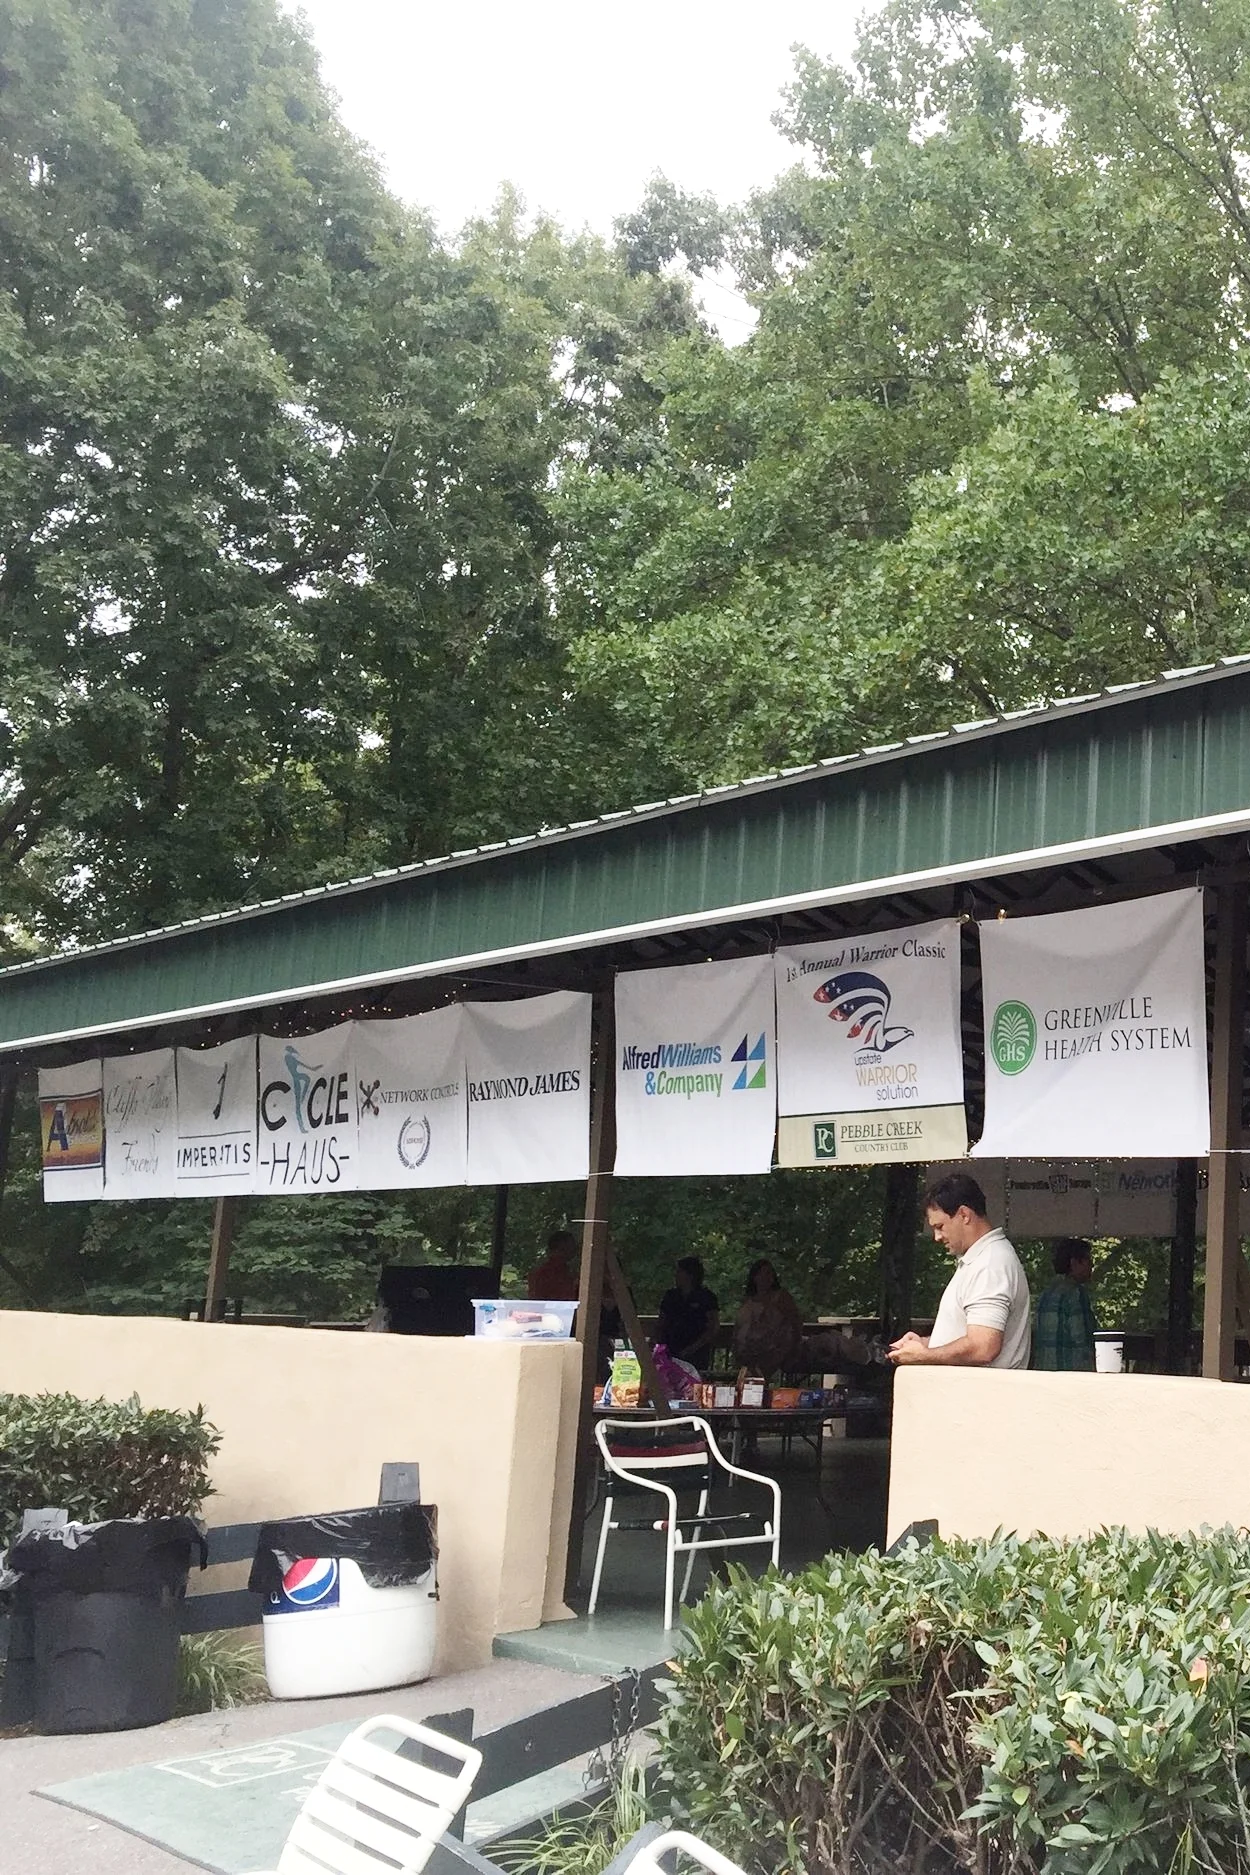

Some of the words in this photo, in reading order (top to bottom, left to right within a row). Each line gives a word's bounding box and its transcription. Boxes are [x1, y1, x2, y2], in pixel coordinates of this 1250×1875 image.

[800, 951, 845, 976] Annual
[850, 944, 898, 964] Warrior
[902, 939, 946, 959] Classic
[1044, 996, 1153, 1031] GREENVILLE
[999, 1043, 1026, 1062] GHS
[1045, 1031, 1102, 1060] HEALTH
[1111, 1026, 1192, 1051] SYSTEM
[855, 1053, 882, 1066] upstate
[856, 1063, 918, 1086] WARRIOR
[469, 1077, 526, 1102] RAYMOND
[529, 1070, 581, 1096] JAMES
[877, 1085, 919, 1101] solution
[380, 1088, 428, 1104] NETWORK
[841, 1123, 884, 1139] PEBBLE
[886, 1121, 923, 1137] CREEK
[854, 1143, 889, 1154] COUNTRY
[890, 1141, 909, 1152] CLUB
